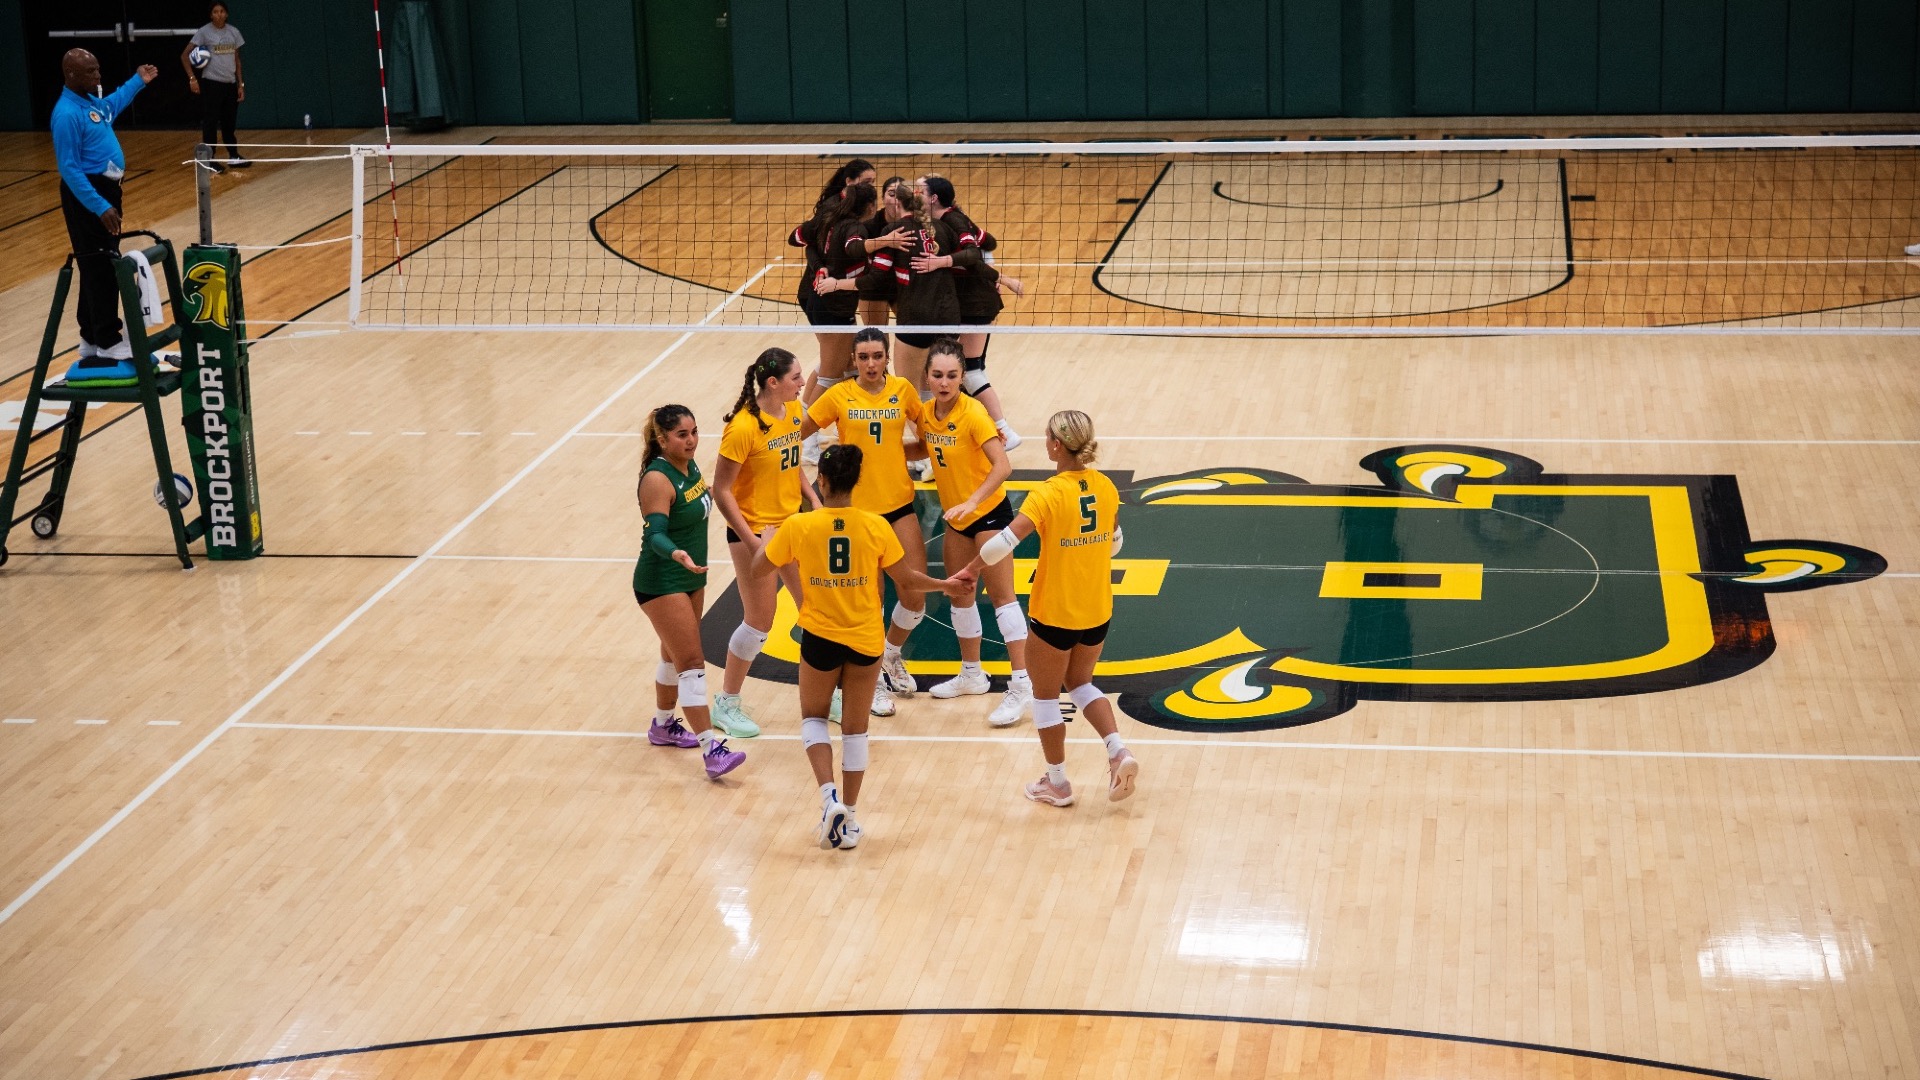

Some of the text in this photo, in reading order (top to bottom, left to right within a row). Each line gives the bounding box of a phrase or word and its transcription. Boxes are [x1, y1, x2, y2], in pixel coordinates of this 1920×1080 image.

[848, 408, 900, 420] BROCKPORT
[868, 421, 882, 445] 9
[196, 343, 237, 548] BROCKPORT
[934, 446, 948, 468] 2
[780, 444, 800, 472] 20
[1078, 494, 1097, 534] 5
[1060, 537, 1088, 548] GOLDEN
[828, 535, 851, 575] 8
[810, 576, 838, 588] GOLDEN
